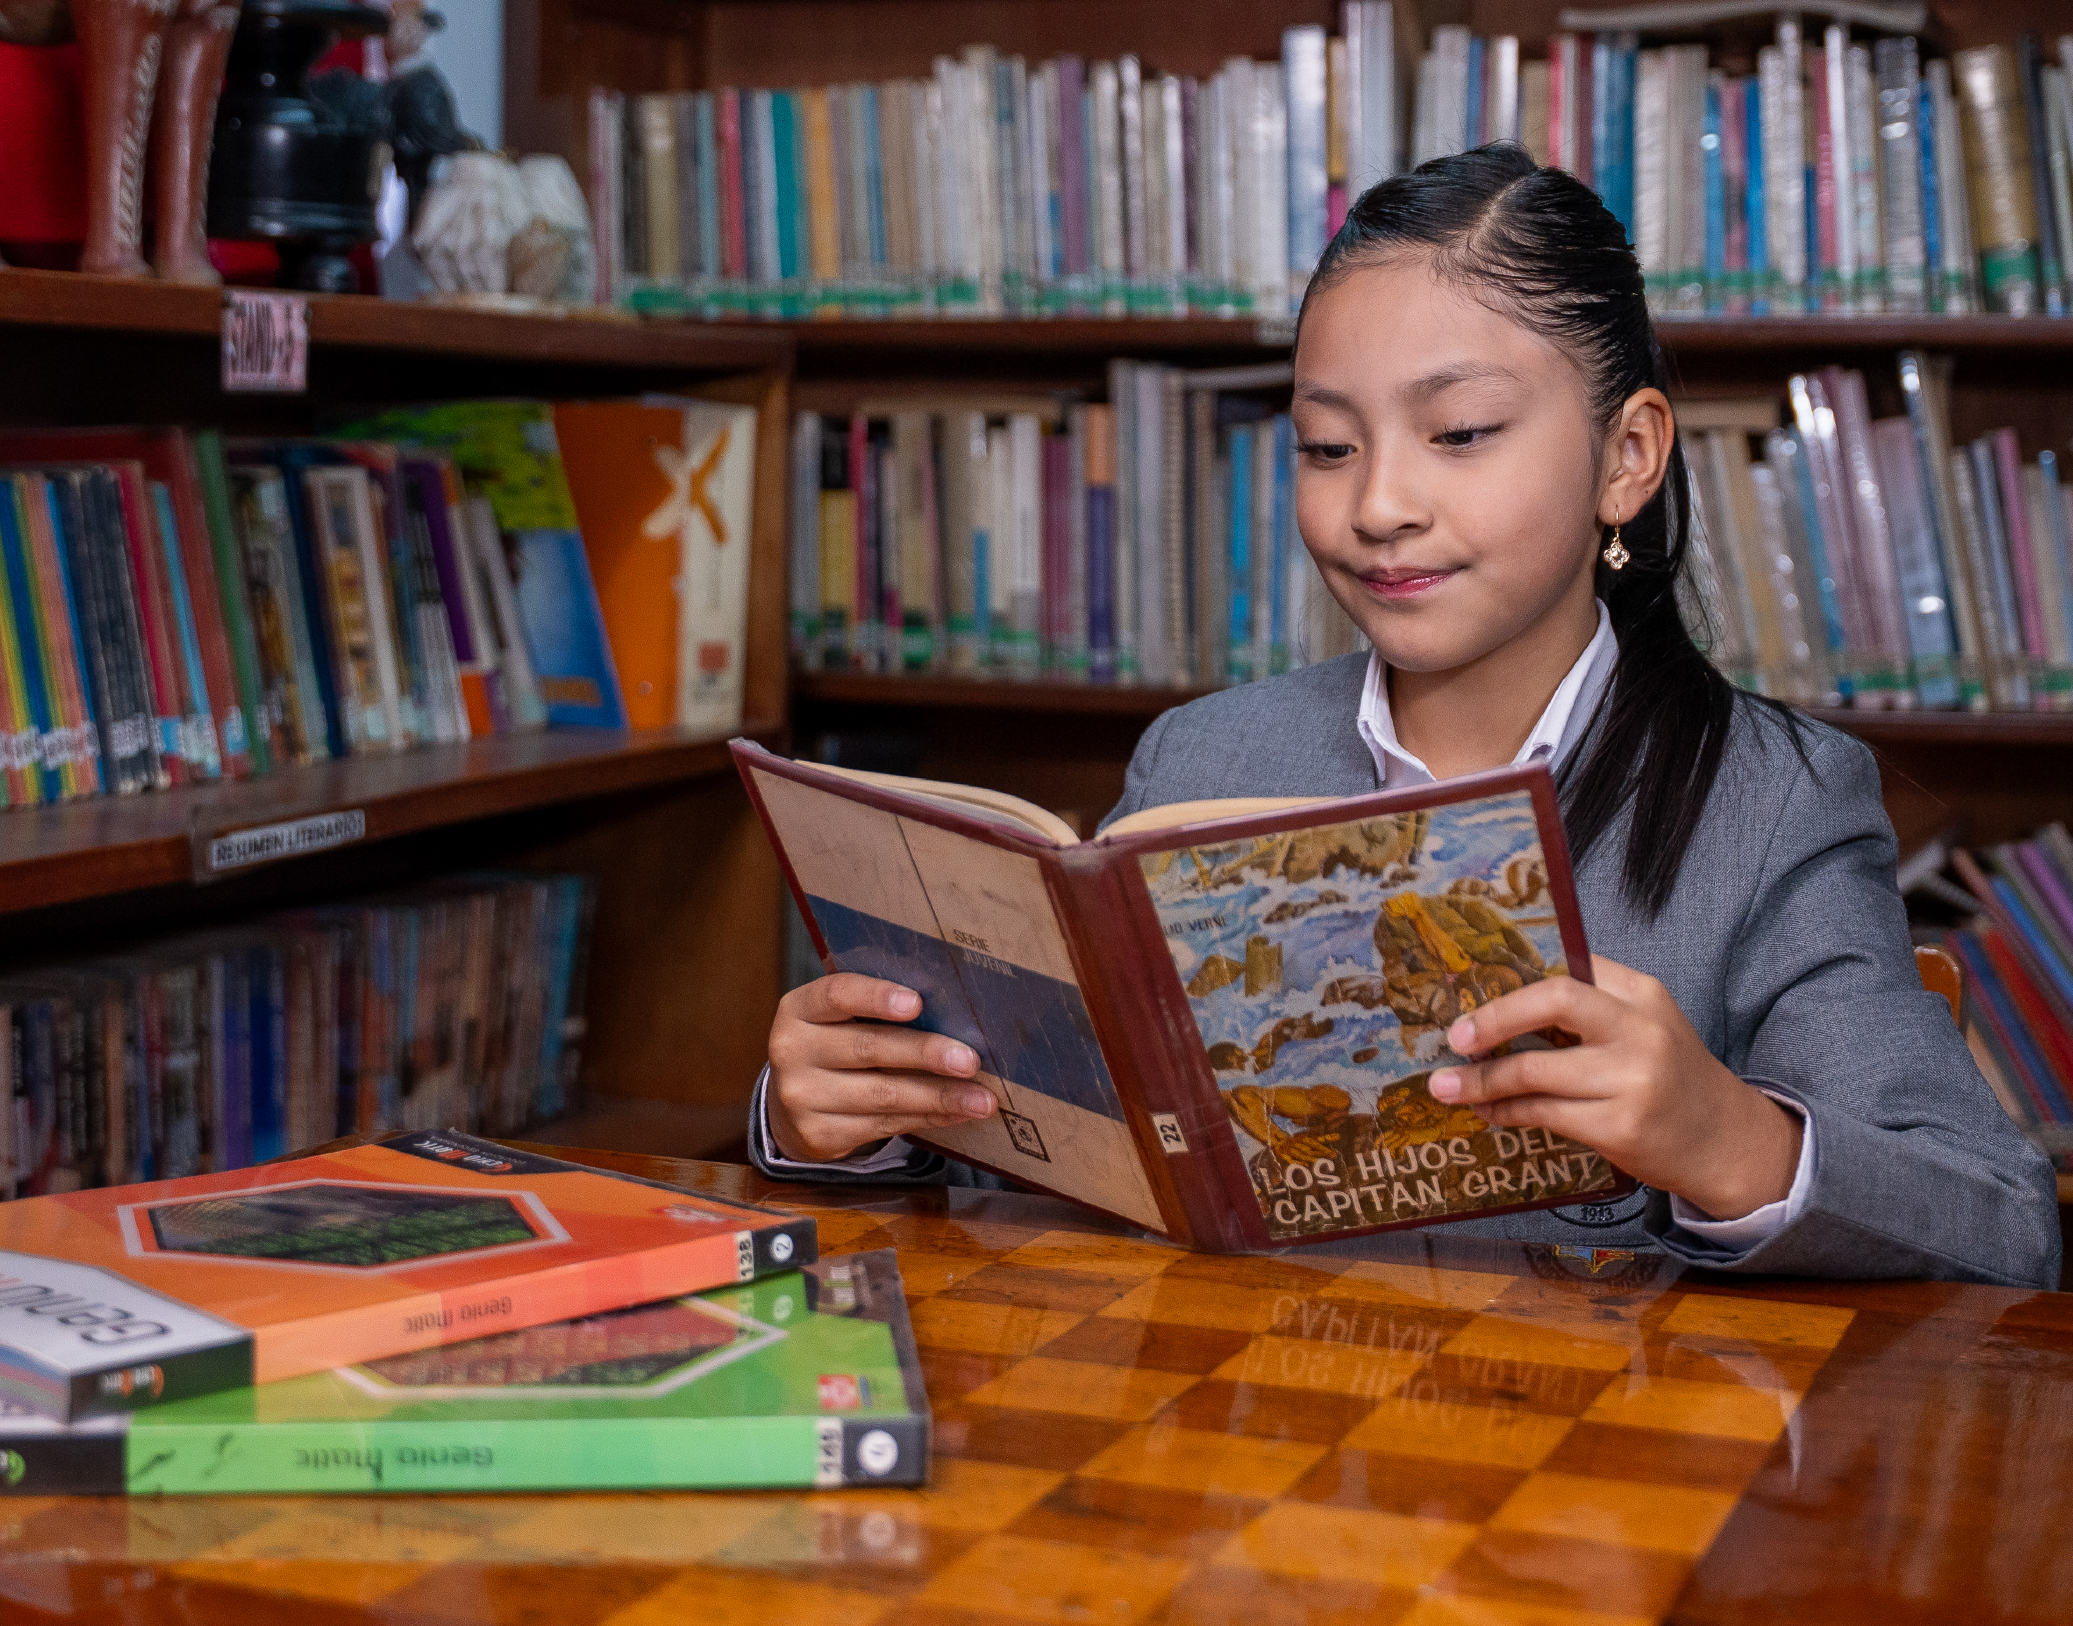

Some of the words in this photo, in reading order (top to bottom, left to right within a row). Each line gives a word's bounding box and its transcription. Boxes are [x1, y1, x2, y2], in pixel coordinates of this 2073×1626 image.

[954, 929, 991, 953] SERIE
[963, 947, 1018, 979] JUVENIL
[1160, 1123, 1182, 1143] 22
[1258, 1157, 1341, 1196] LOS
[1355, 1136, 1477, 1181] HIJOS
[1493, 1126, 1568, 1160] DEL
[1274, 1174, 1444, 1225] CAPITAN
[1462, 1150, 1597, 1198] GRANT
[1580, 1205, 1616, 1222] 1913
